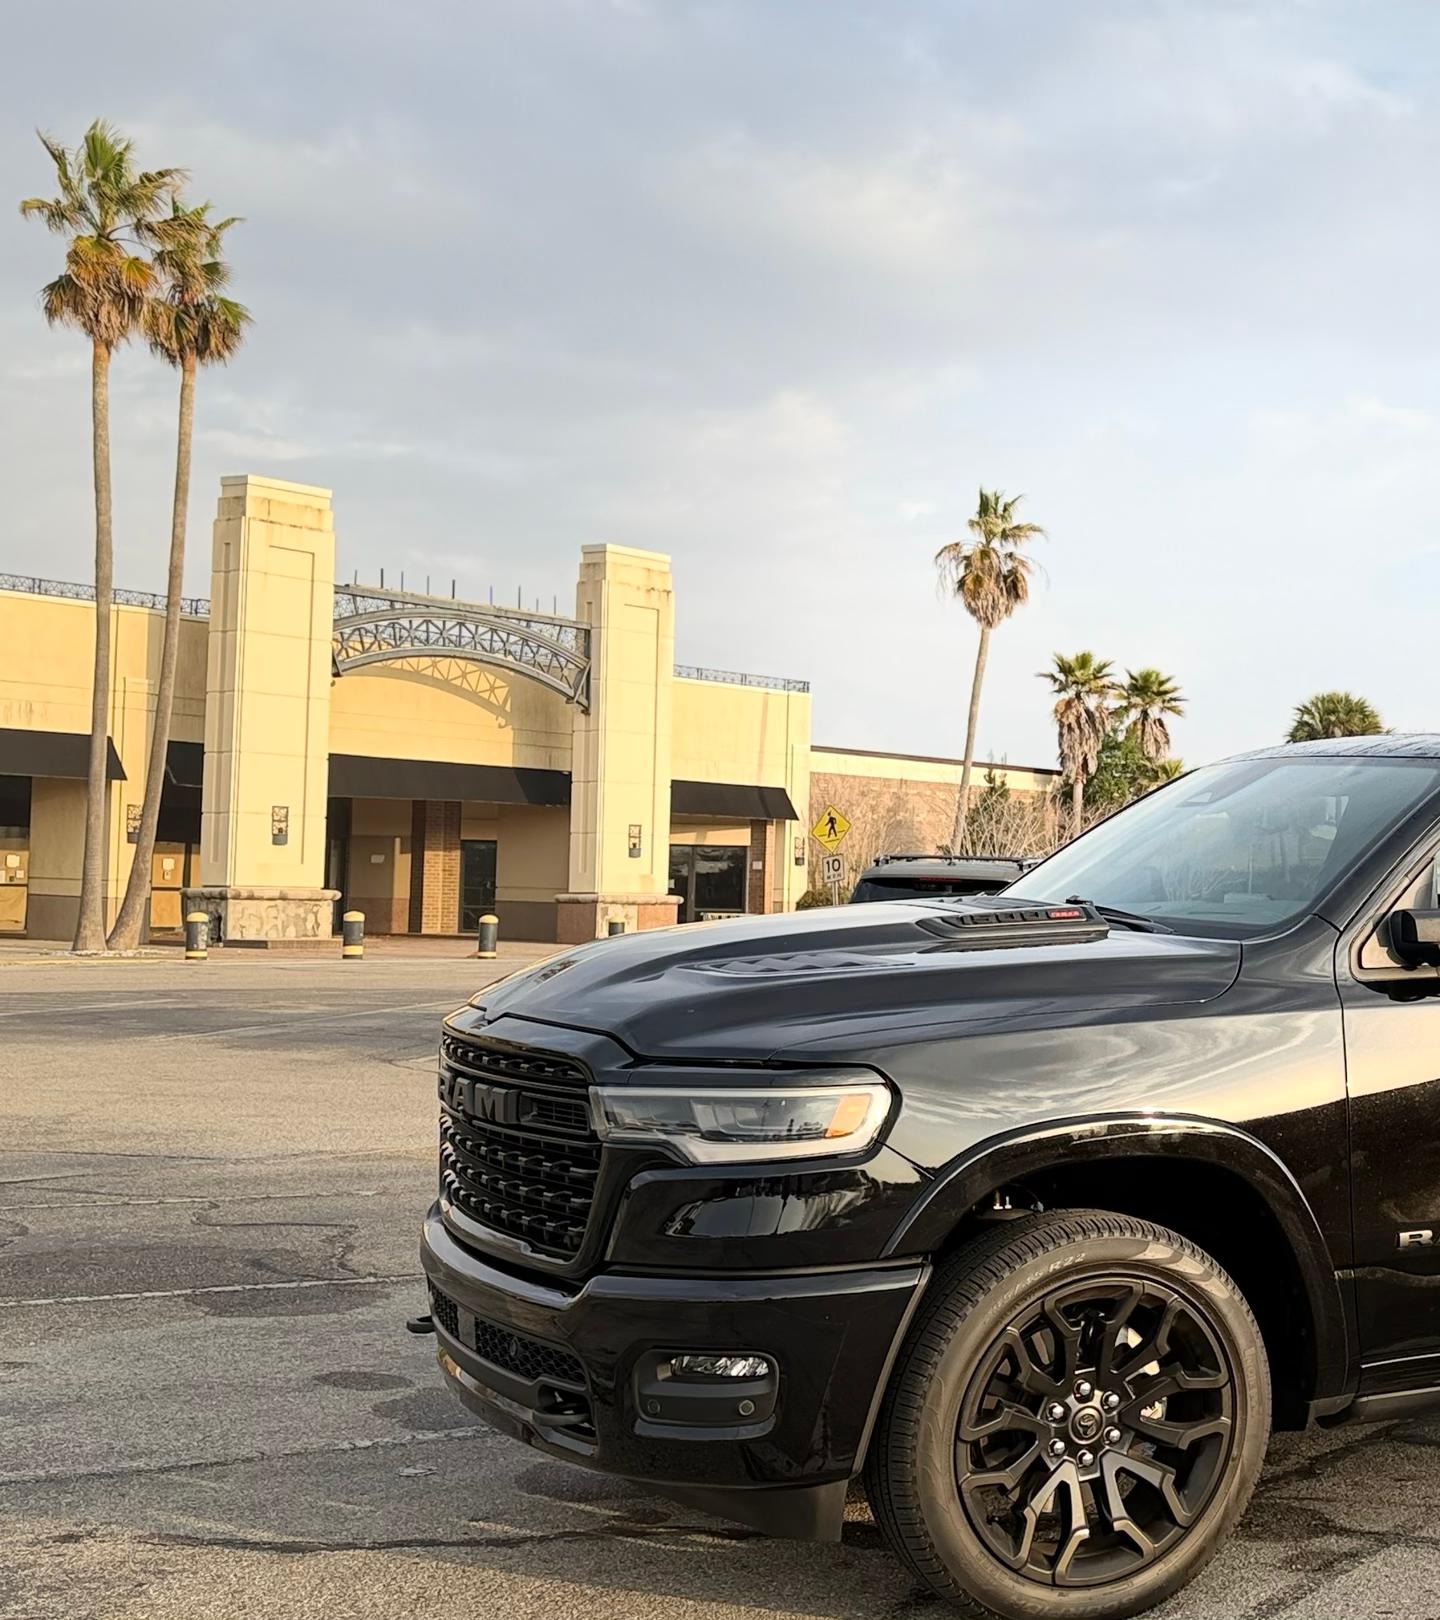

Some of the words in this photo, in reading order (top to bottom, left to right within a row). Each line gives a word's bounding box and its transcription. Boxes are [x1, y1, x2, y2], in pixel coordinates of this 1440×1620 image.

[826, 858, 841, 873] 10
[961, 911, 1047, 926] 1500
[439, 1069, 520, 1124] RAM
[1049, 1252, 1086, 1273] R22
